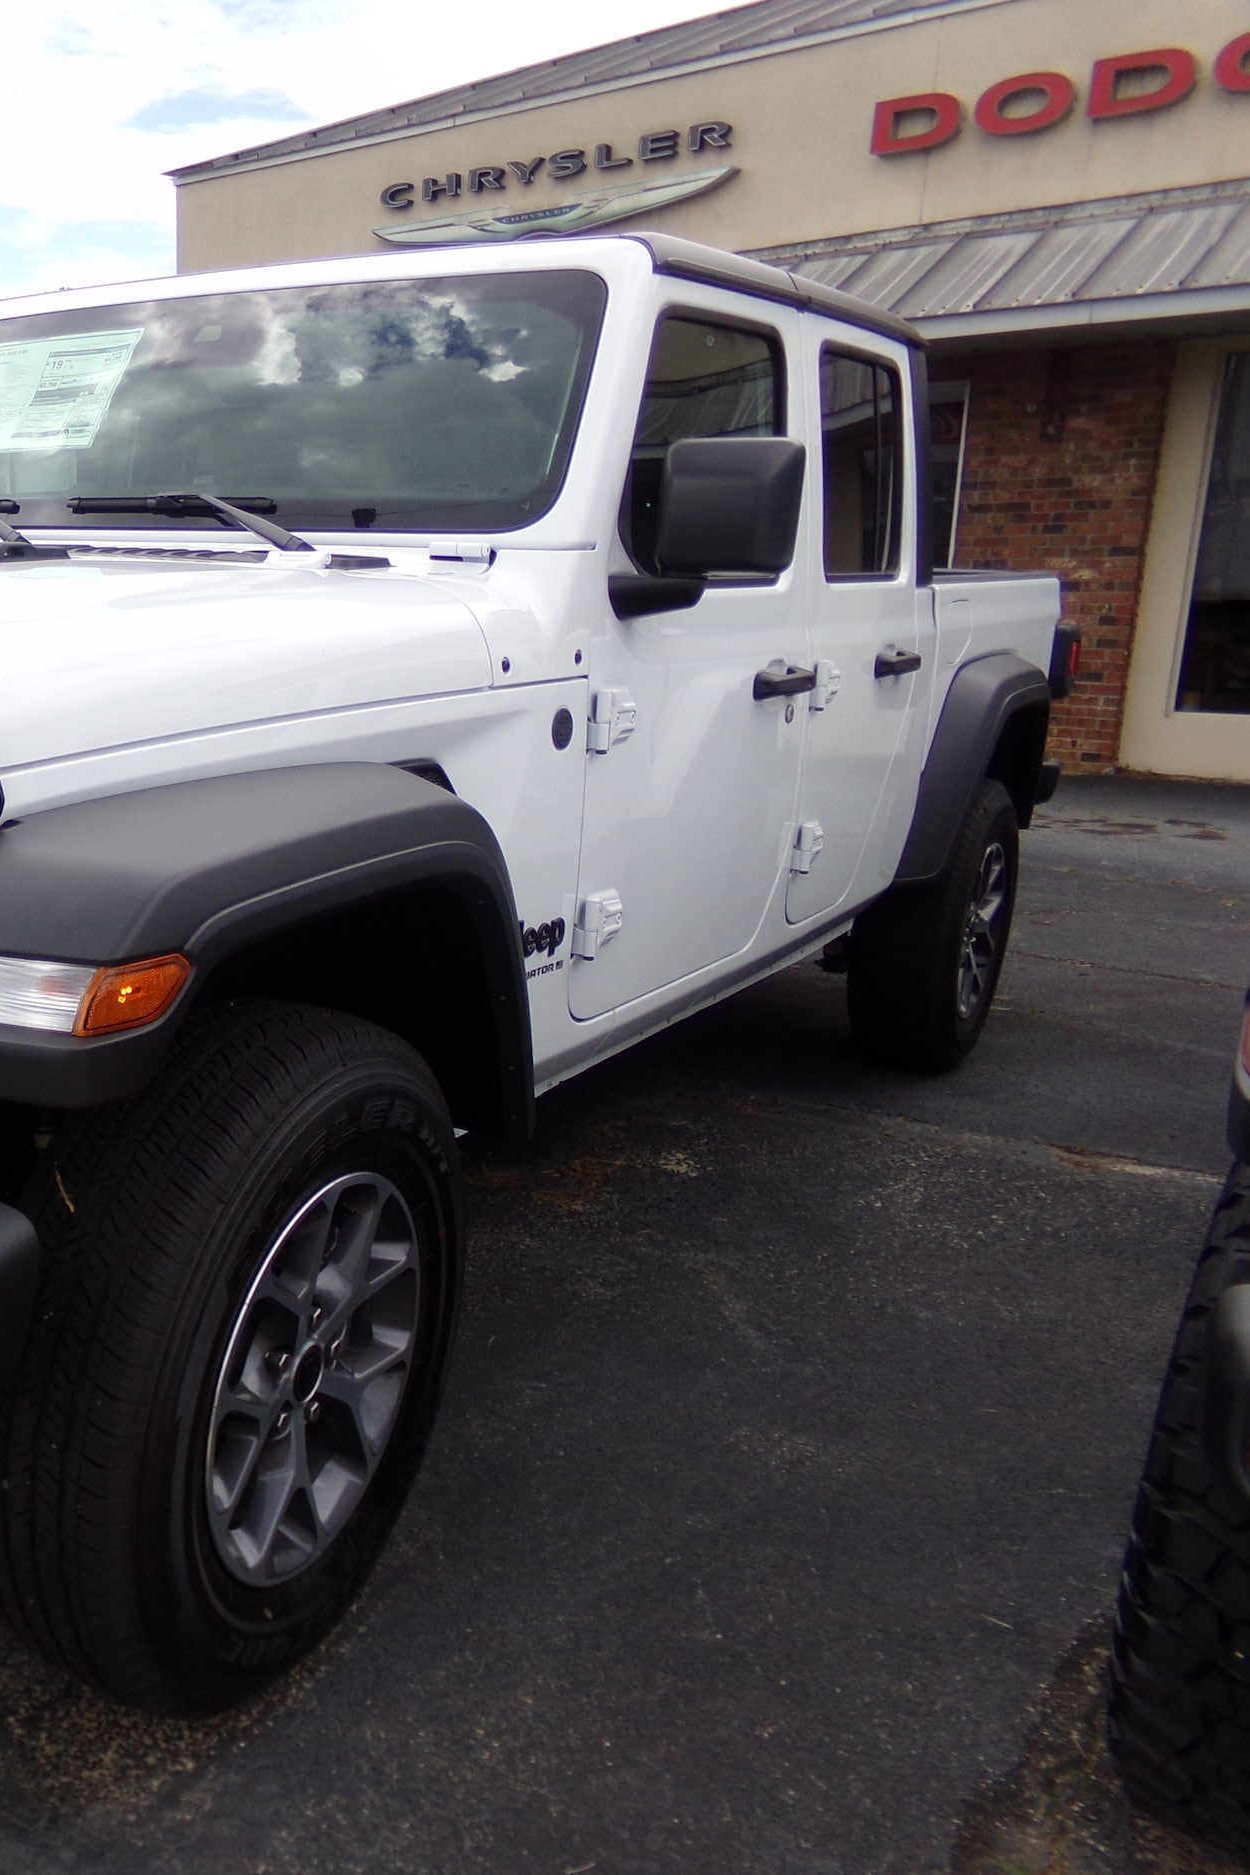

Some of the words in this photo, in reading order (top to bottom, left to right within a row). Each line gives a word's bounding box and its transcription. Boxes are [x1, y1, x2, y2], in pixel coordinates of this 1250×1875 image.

[379, 121, 733, 209] CHRYSLER
[52, 360, 63, 370] 19
[526, 962, 554, 980] IATOR
